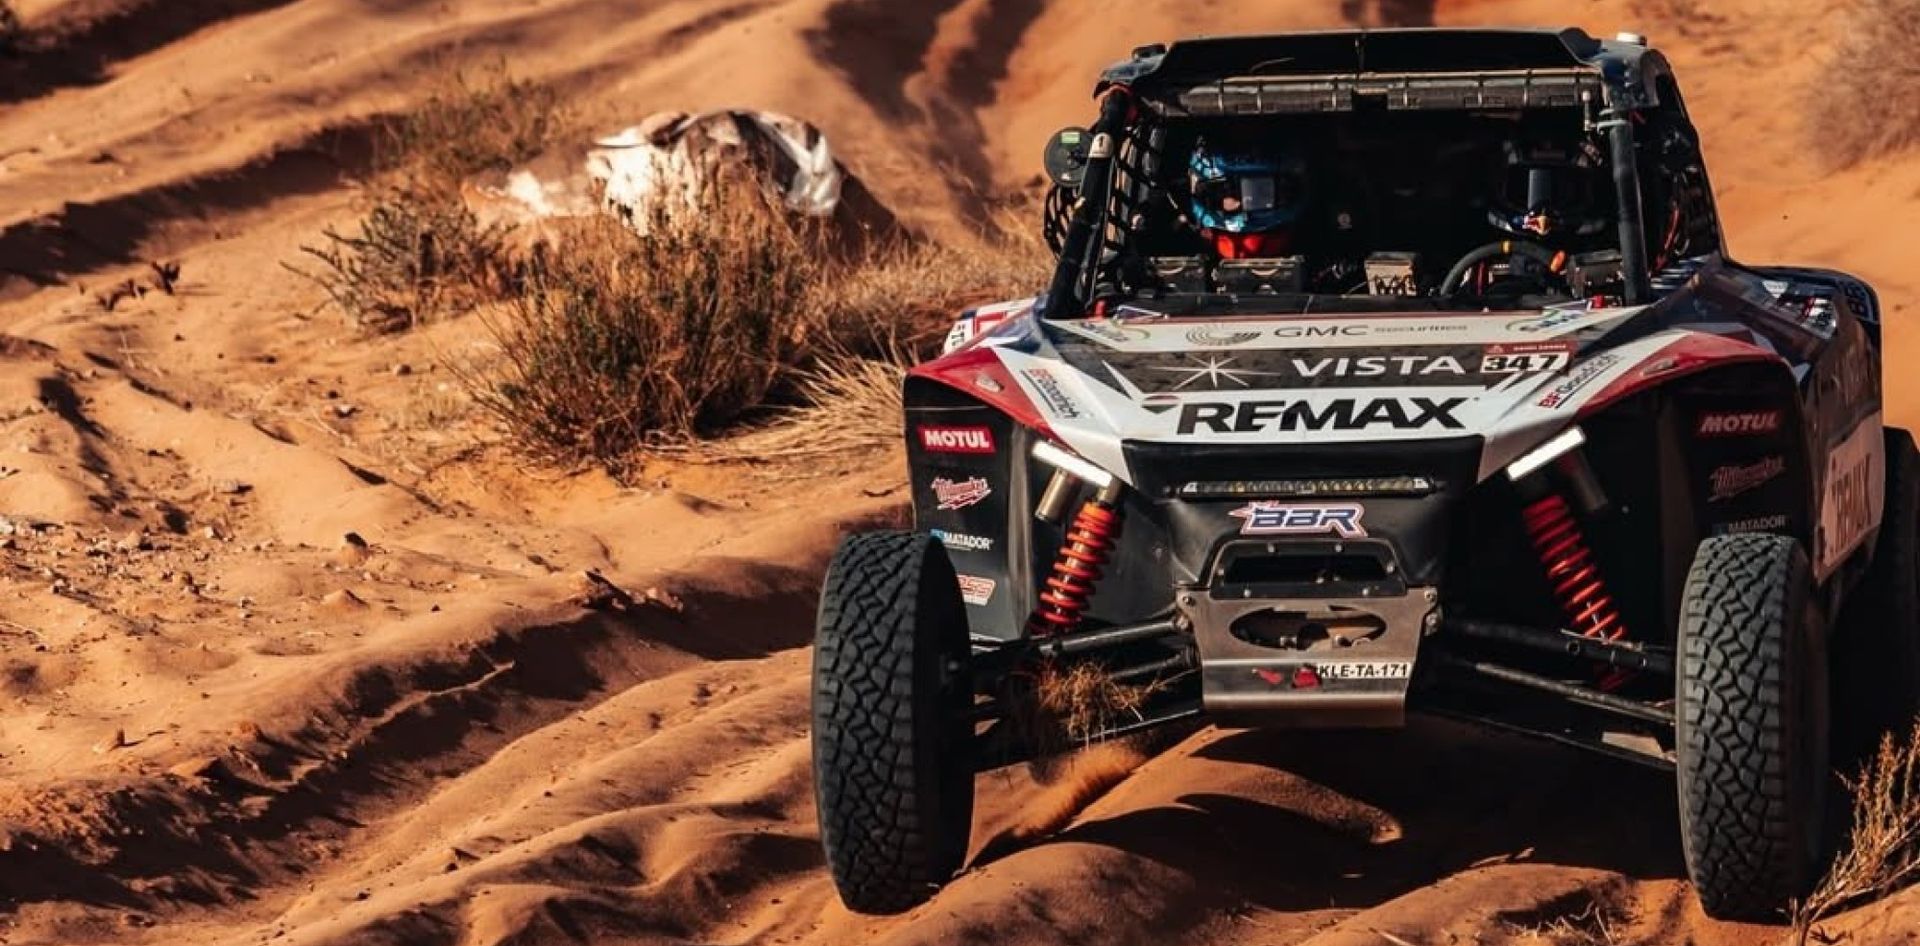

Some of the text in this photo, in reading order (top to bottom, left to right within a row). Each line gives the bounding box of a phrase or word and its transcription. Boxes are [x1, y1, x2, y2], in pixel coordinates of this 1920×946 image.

[1275, 324, 1369, 338] GMC
[1292, 355, 1467, 378] VISTA
[1484, 354, 1560, 371] 347
[1176, 396, 1470, 435] REMAX
[1701, 411, 1778, 433] MOTUL
[924, 430, 990, 448] MOTUL
[1247, 504, 1361, 534] BBR
[1319, 663, 1408, 678] KLE-TA-171
